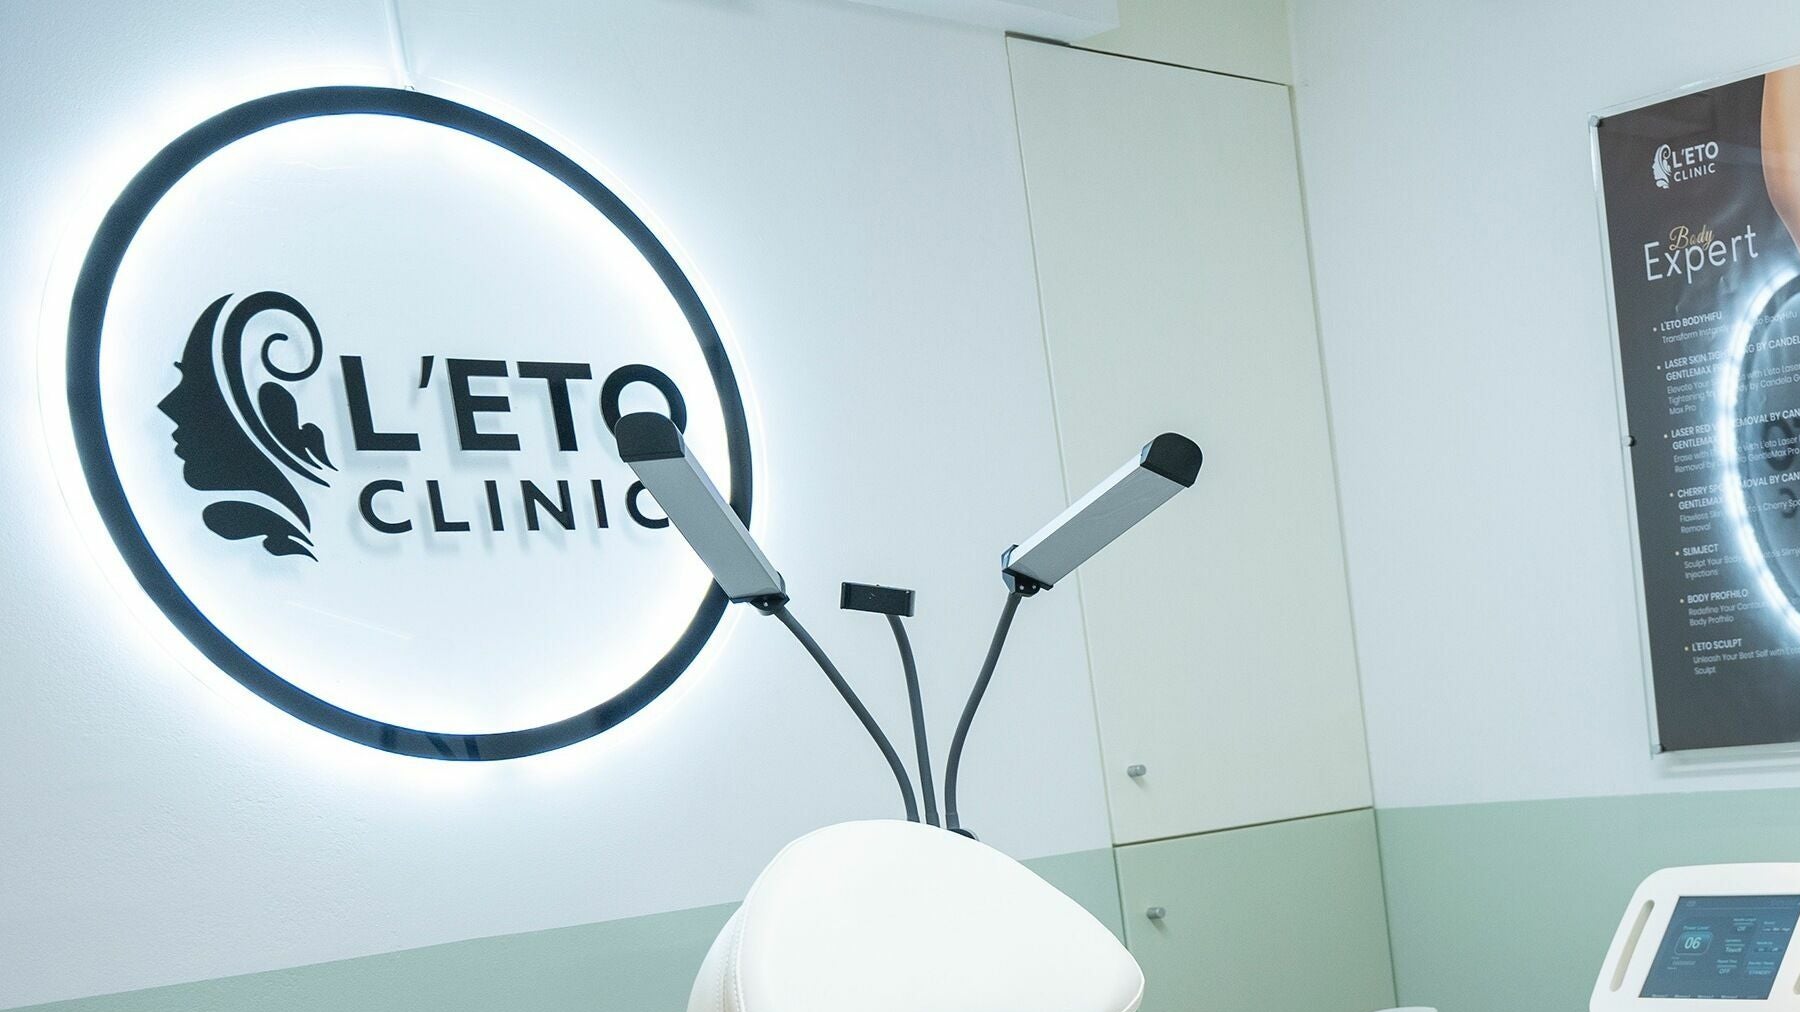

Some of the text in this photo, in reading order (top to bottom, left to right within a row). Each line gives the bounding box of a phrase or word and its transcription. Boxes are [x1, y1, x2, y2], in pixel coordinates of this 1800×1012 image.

[1672, 141, 1719, 169] L'ETO
[1673, 163, 1716, 182] CLINIC
[1669, 224, 1714, 252] Body
[1644, 224, 1759, 284] Expert
[341, 355, 687, 452] L'ETO
[1734, 415, 1768, 428] EMOVAL
[1770, 412, 1780, 422] BY
[1769, 475, 1780, 485] BY
[359, 478, 670, 534] CLINIC
[1687, 593, 1709, 604] BODY
[1684, 936, 1702, 950] 06
